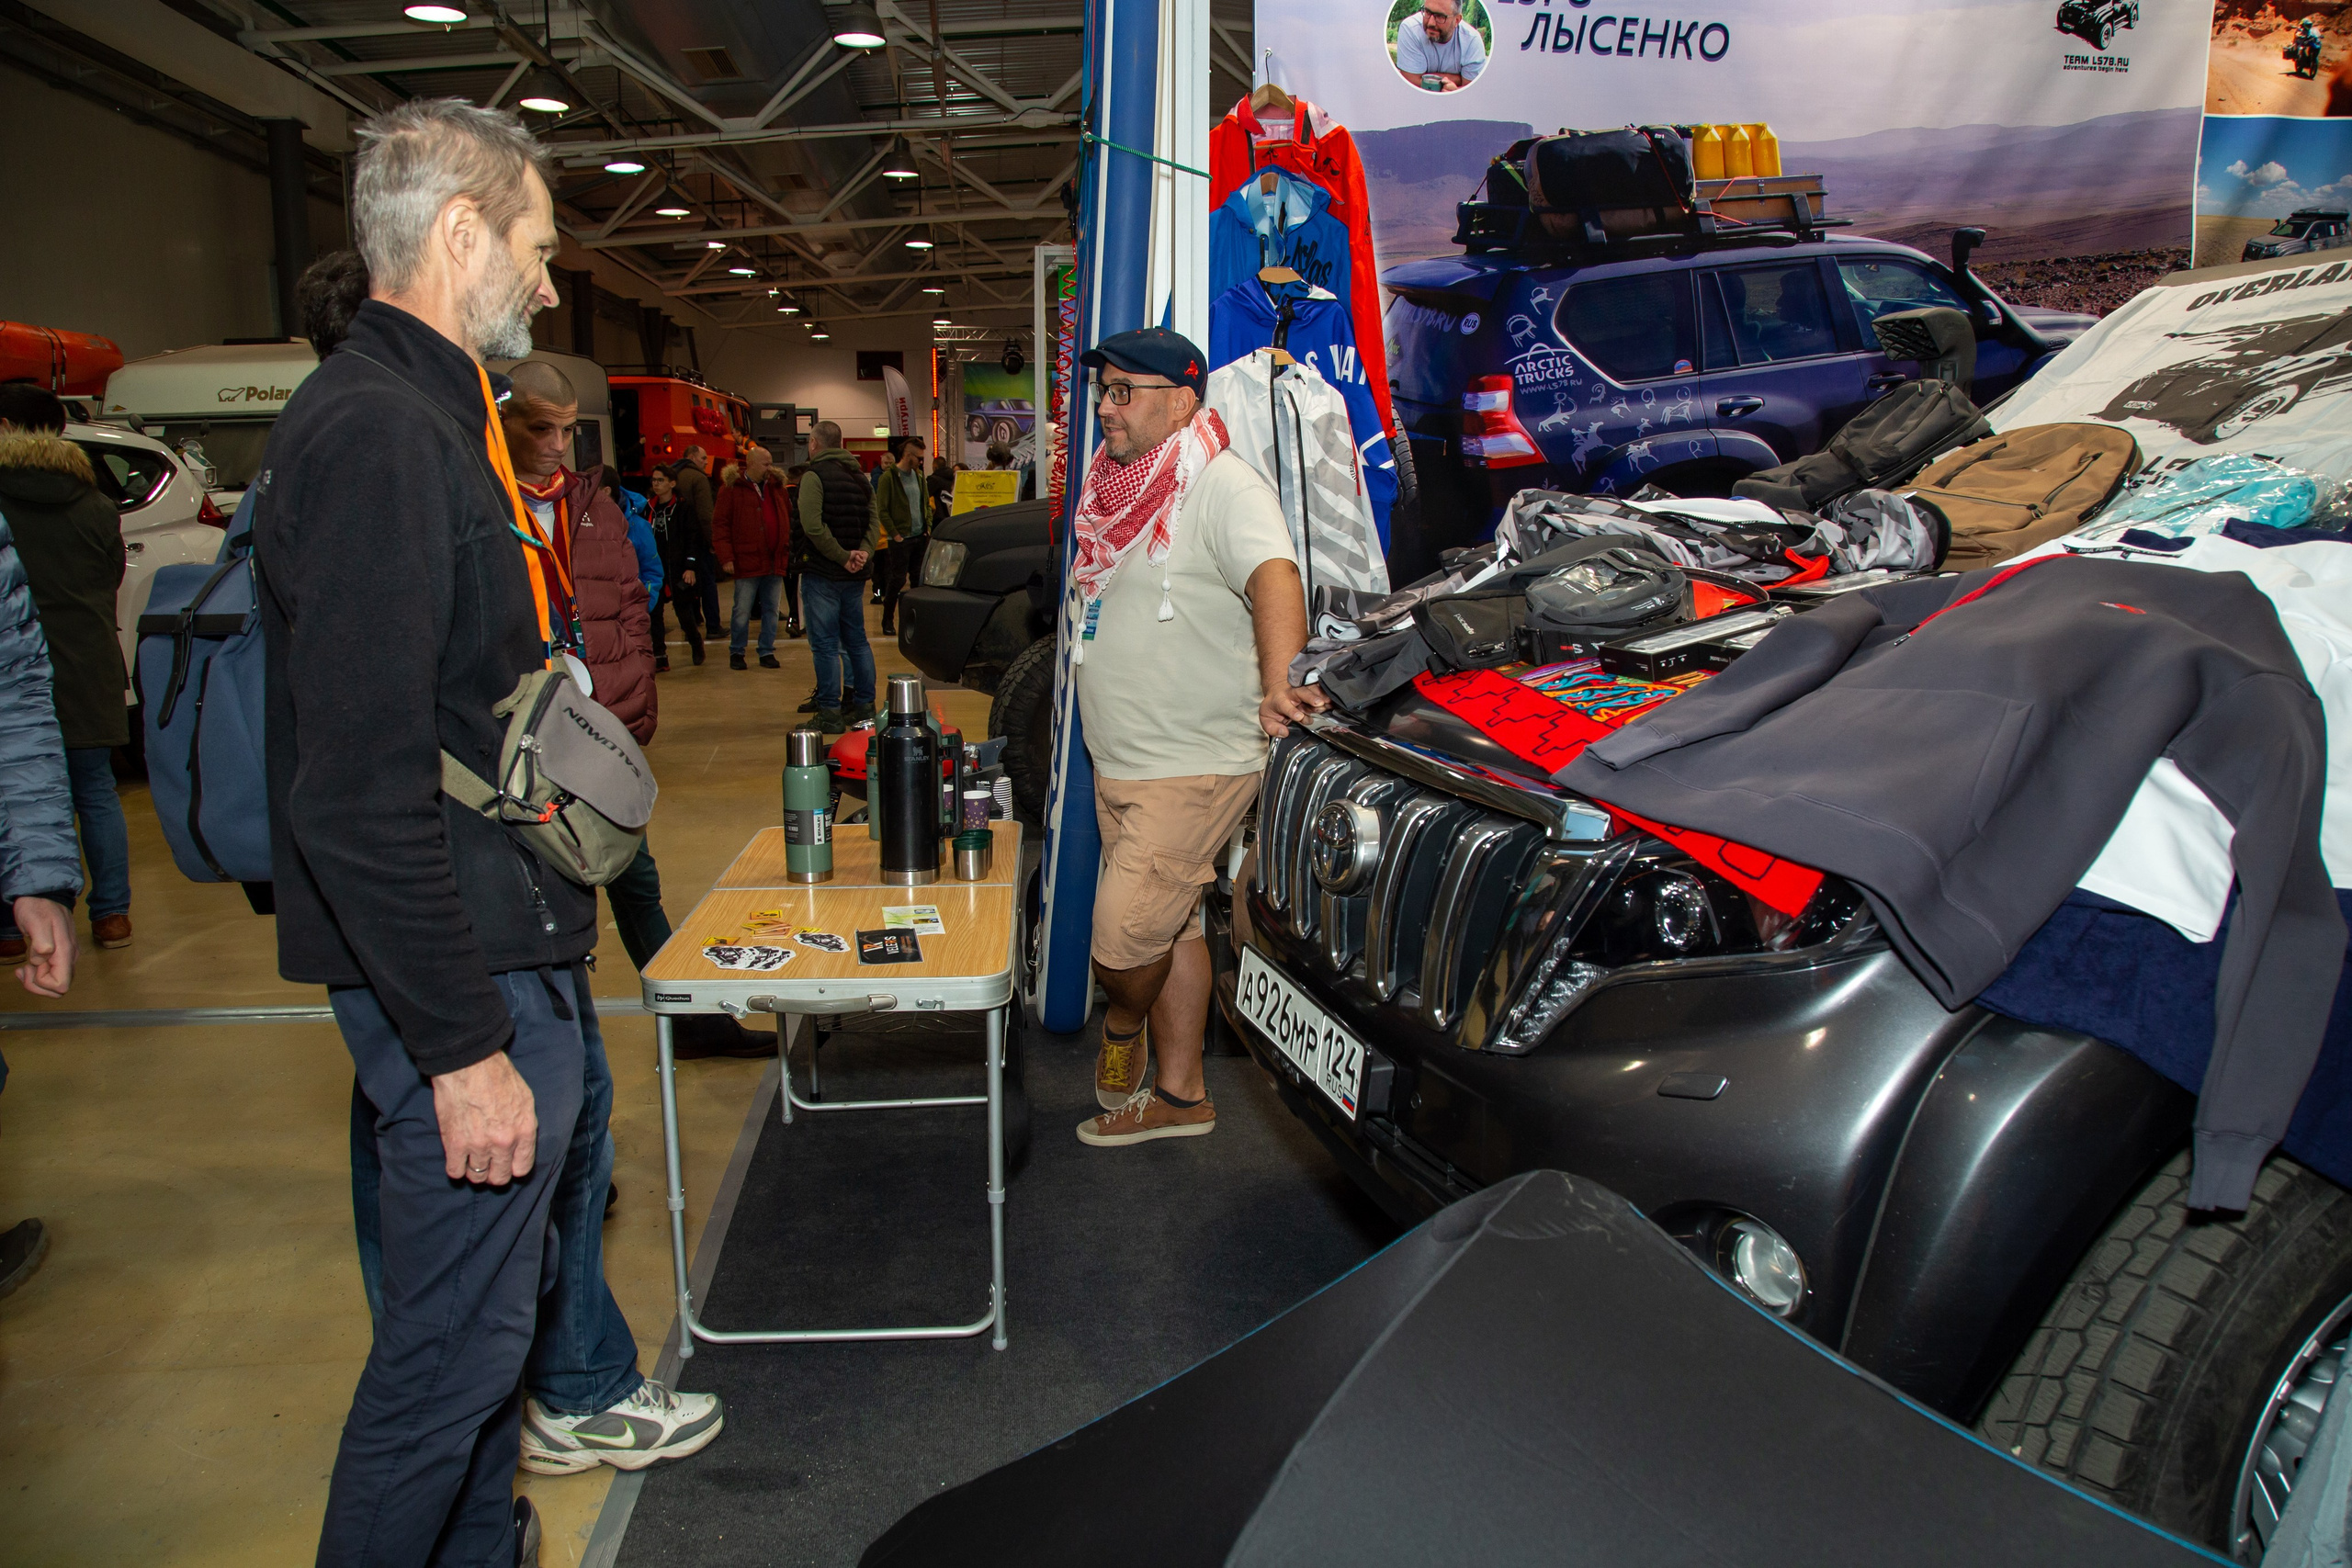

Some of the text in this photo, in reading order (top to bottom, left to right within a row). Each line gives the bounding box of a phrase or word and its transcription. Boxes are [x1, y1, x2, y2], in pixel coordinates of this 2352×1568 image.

[1521, 13, 1729, 62] ЛЫСЕНКО
[2064, 55, 2130, 66] TEAM LS78.RU
[1463, 318, 1477, 329] RUS
[1514, 355, 1571, 375] ARCTIC
[1515, 366, 1574, 385] TRUCKS
[244, 385, 292, 401] Polar
[562, 706, 641, 779] SALOMON
[884, 935, 899, 954] VELERS
[1324, 1027, 1359, 1094] 124
[1326, 1072, 1343, 1100] RUS
